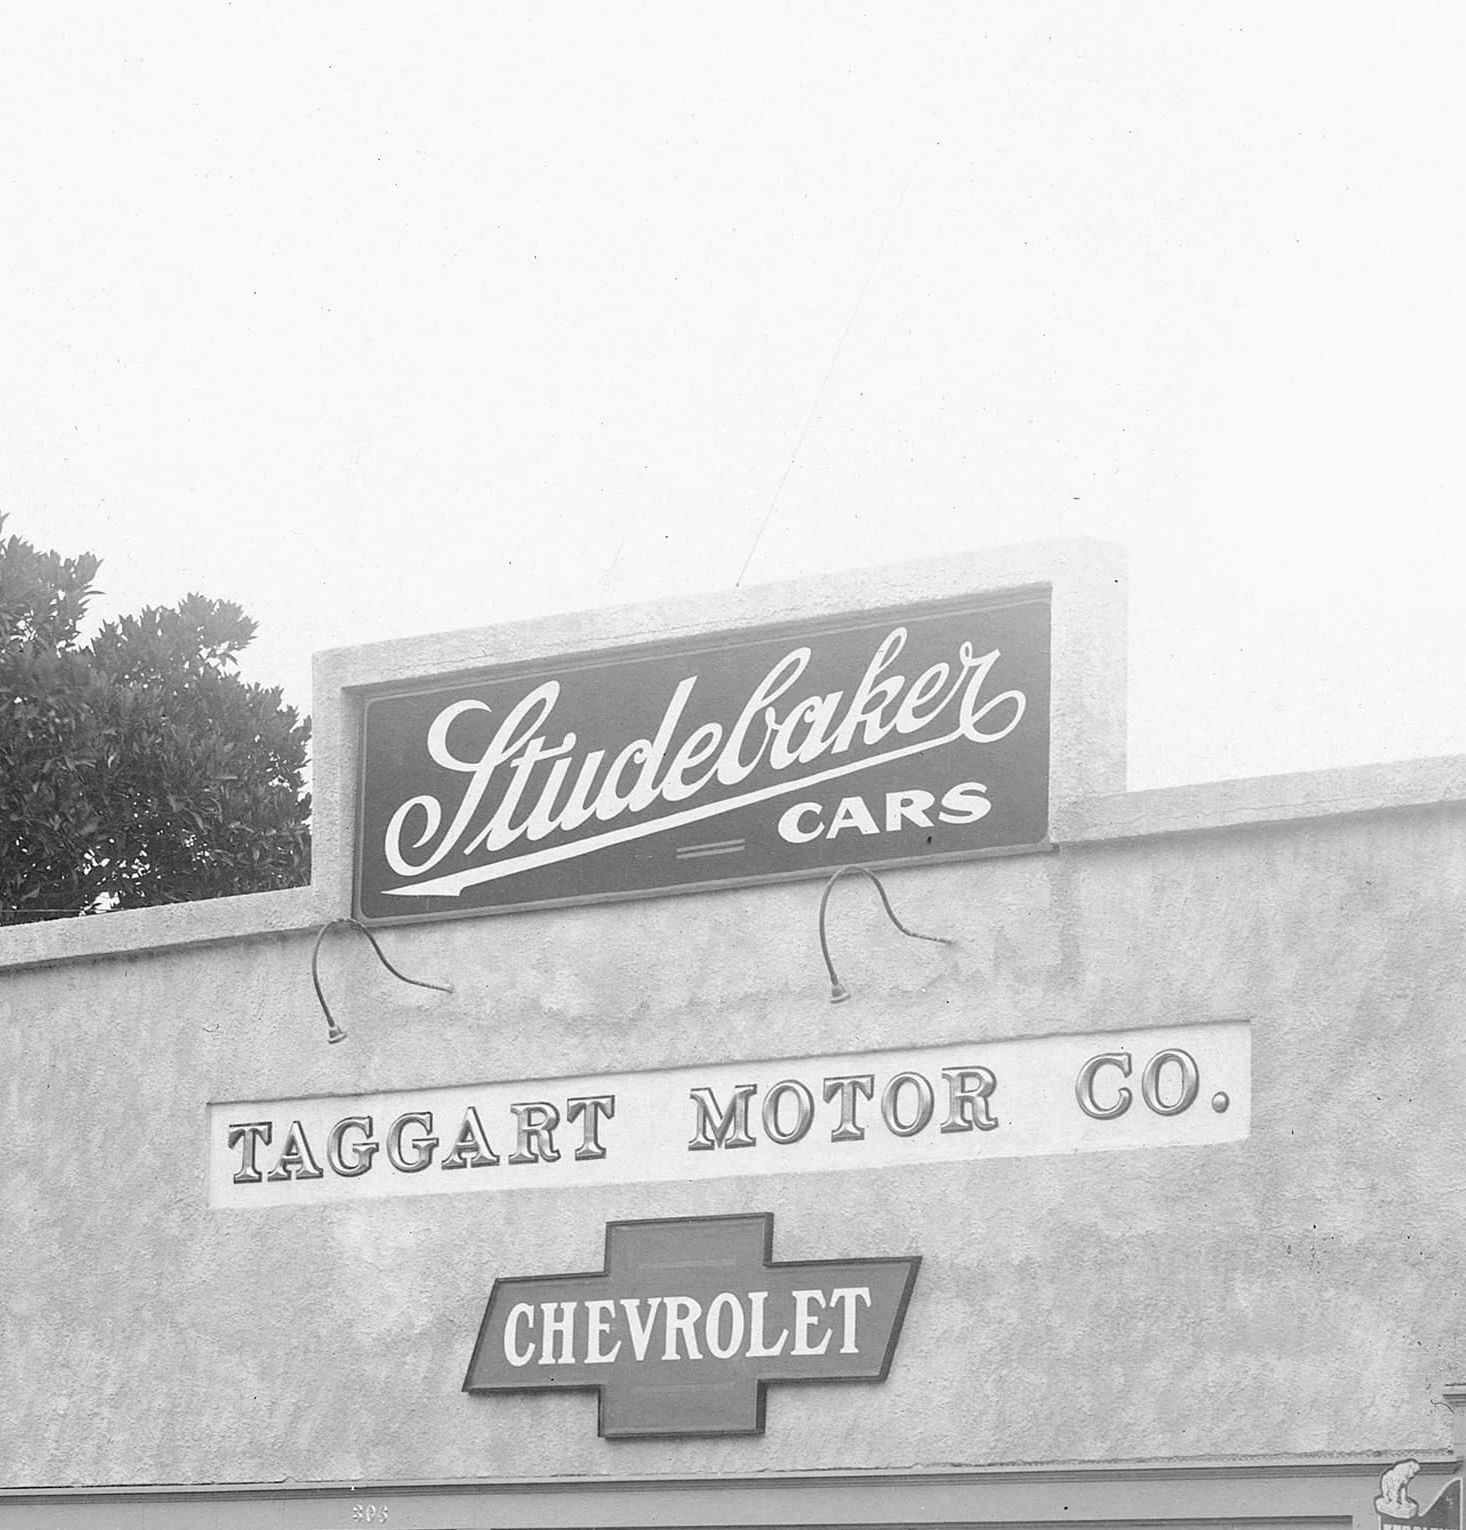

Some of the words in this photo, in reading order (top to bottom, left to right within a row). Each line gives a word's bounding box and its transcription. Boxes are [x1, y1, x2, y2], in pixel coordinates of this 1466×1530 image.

[381, 627, 1026, 896] Studebaker
[778, 781, 992, 844] CARS
[227, 1094, 615, 1185] TAGGART
[687, 1066, 999, 1152] MOTOR
[1075, 1048, 1231, 1120] CO.
[502, 1285, 873, 1367] CHEVROLET
